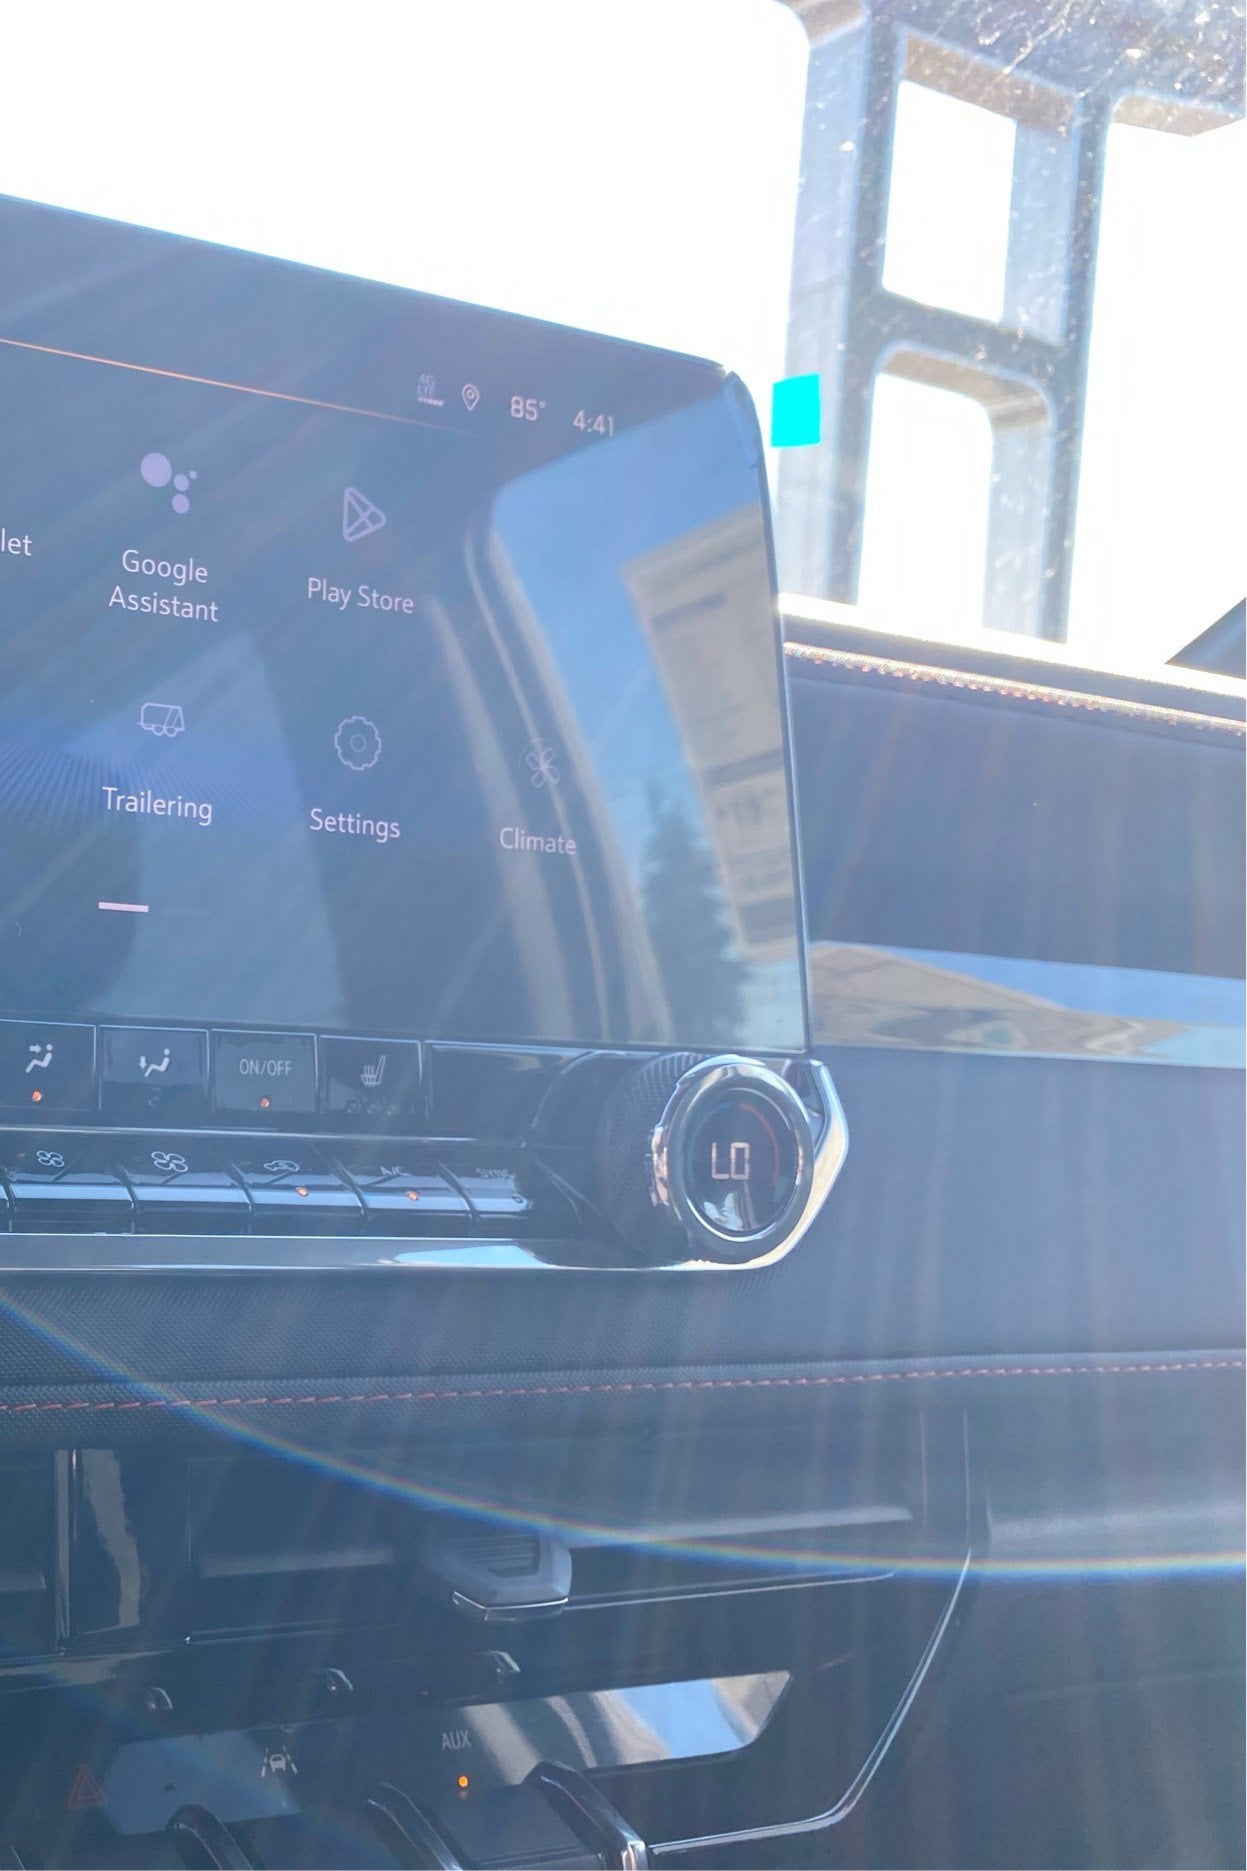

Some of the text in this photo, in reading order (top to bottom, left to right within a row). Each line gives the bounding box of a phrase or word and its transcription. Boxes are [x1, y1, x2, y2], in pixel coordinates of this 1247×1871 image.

[572, 408, 615, 438] 4:41
[121, 549, 209, 587] Google
[108, 586, 220, 623] Assistant
[307, 577, 415, 614] Play Store
[101, 786, 214, 827] Trailering
[309, 807, 400, 842] Settings
[498, 827, 577, 857] Climate
[238, 1057, 293, 1078] ON/OFF
[710, 1141, 751, 1181] LO
[440, 1730, 472, 1750] AUX
